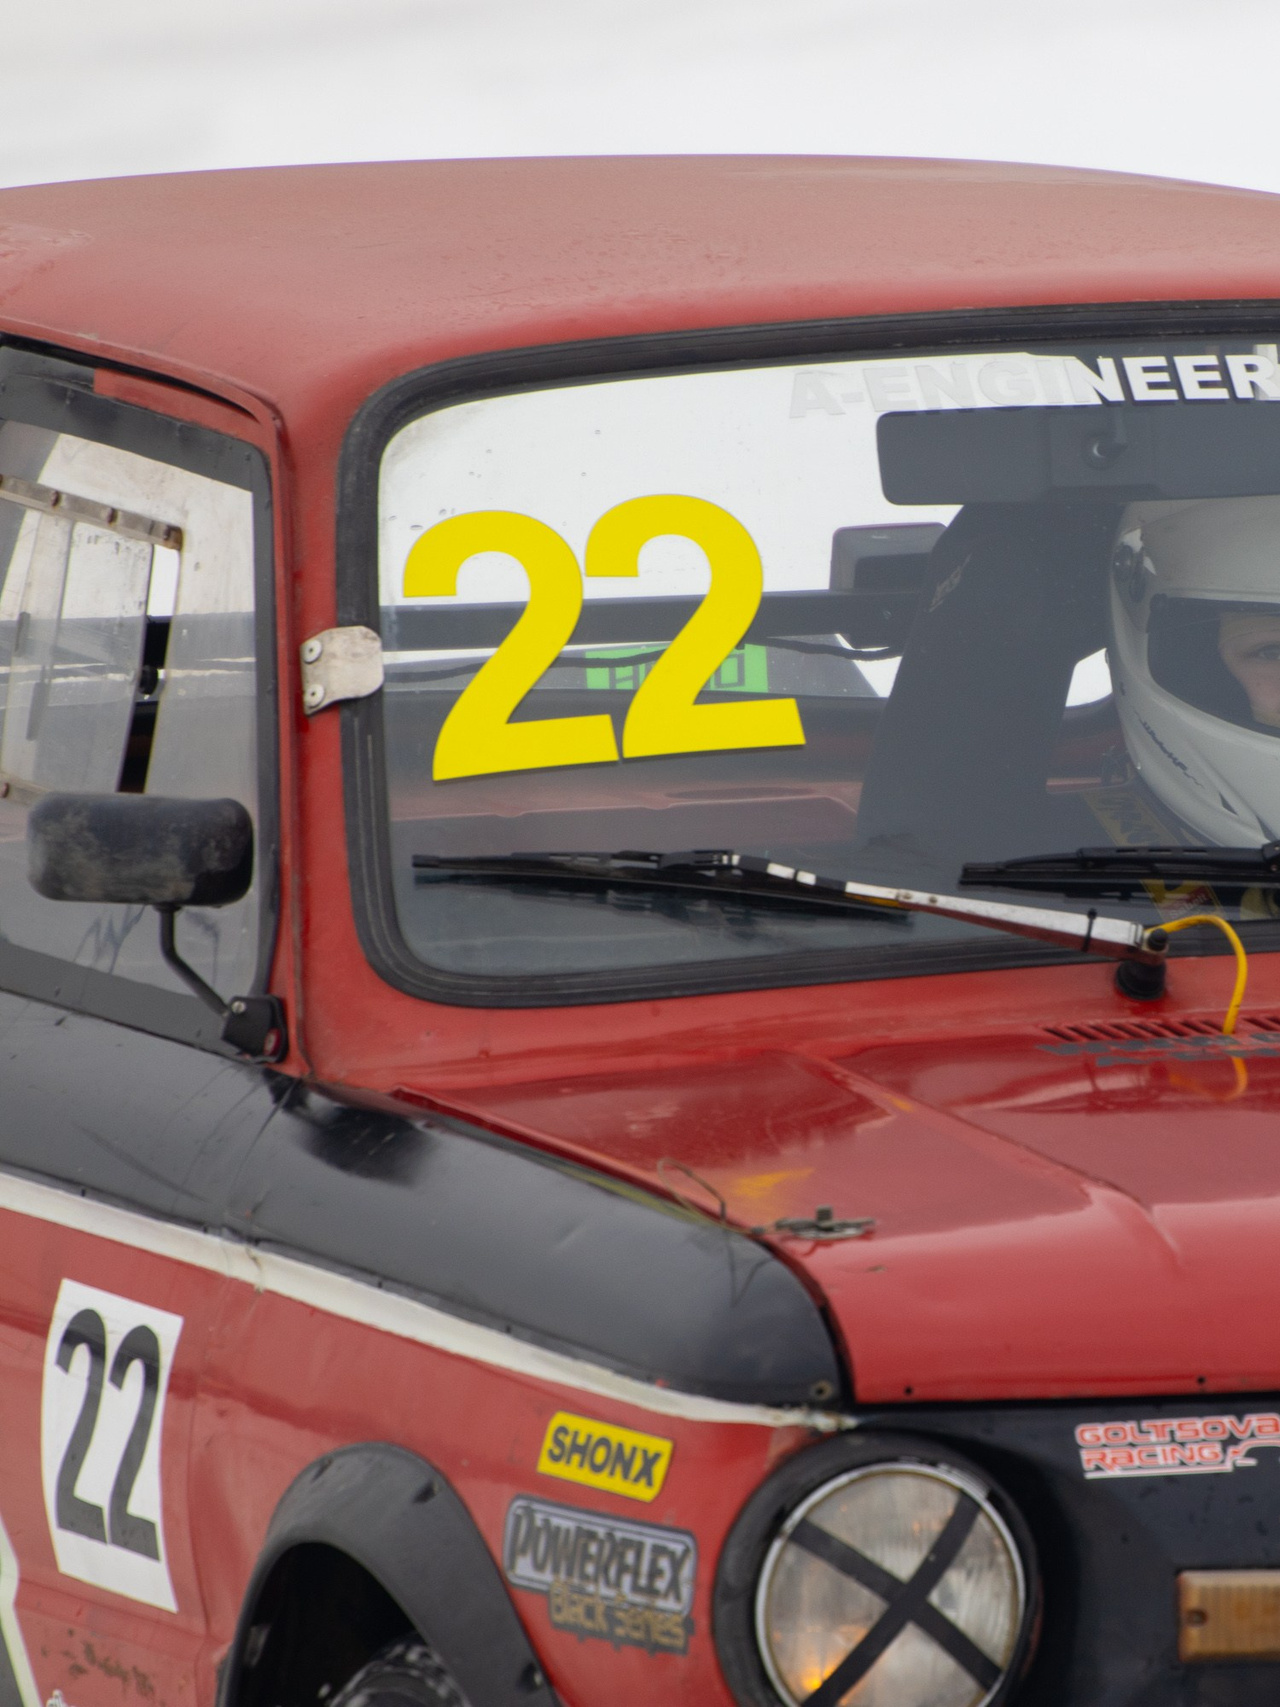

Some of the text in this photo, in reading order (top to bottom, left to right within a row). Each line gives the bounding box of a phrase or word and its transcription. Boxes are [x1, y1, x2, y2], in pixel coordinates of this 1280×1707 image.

[403, 494, 806, 781] 22
[55, 1308, 161, 1563] 22
[547, 1425, 662, 1487] SHONX
[508, 1506, 691, 1604] POWERFLEX
